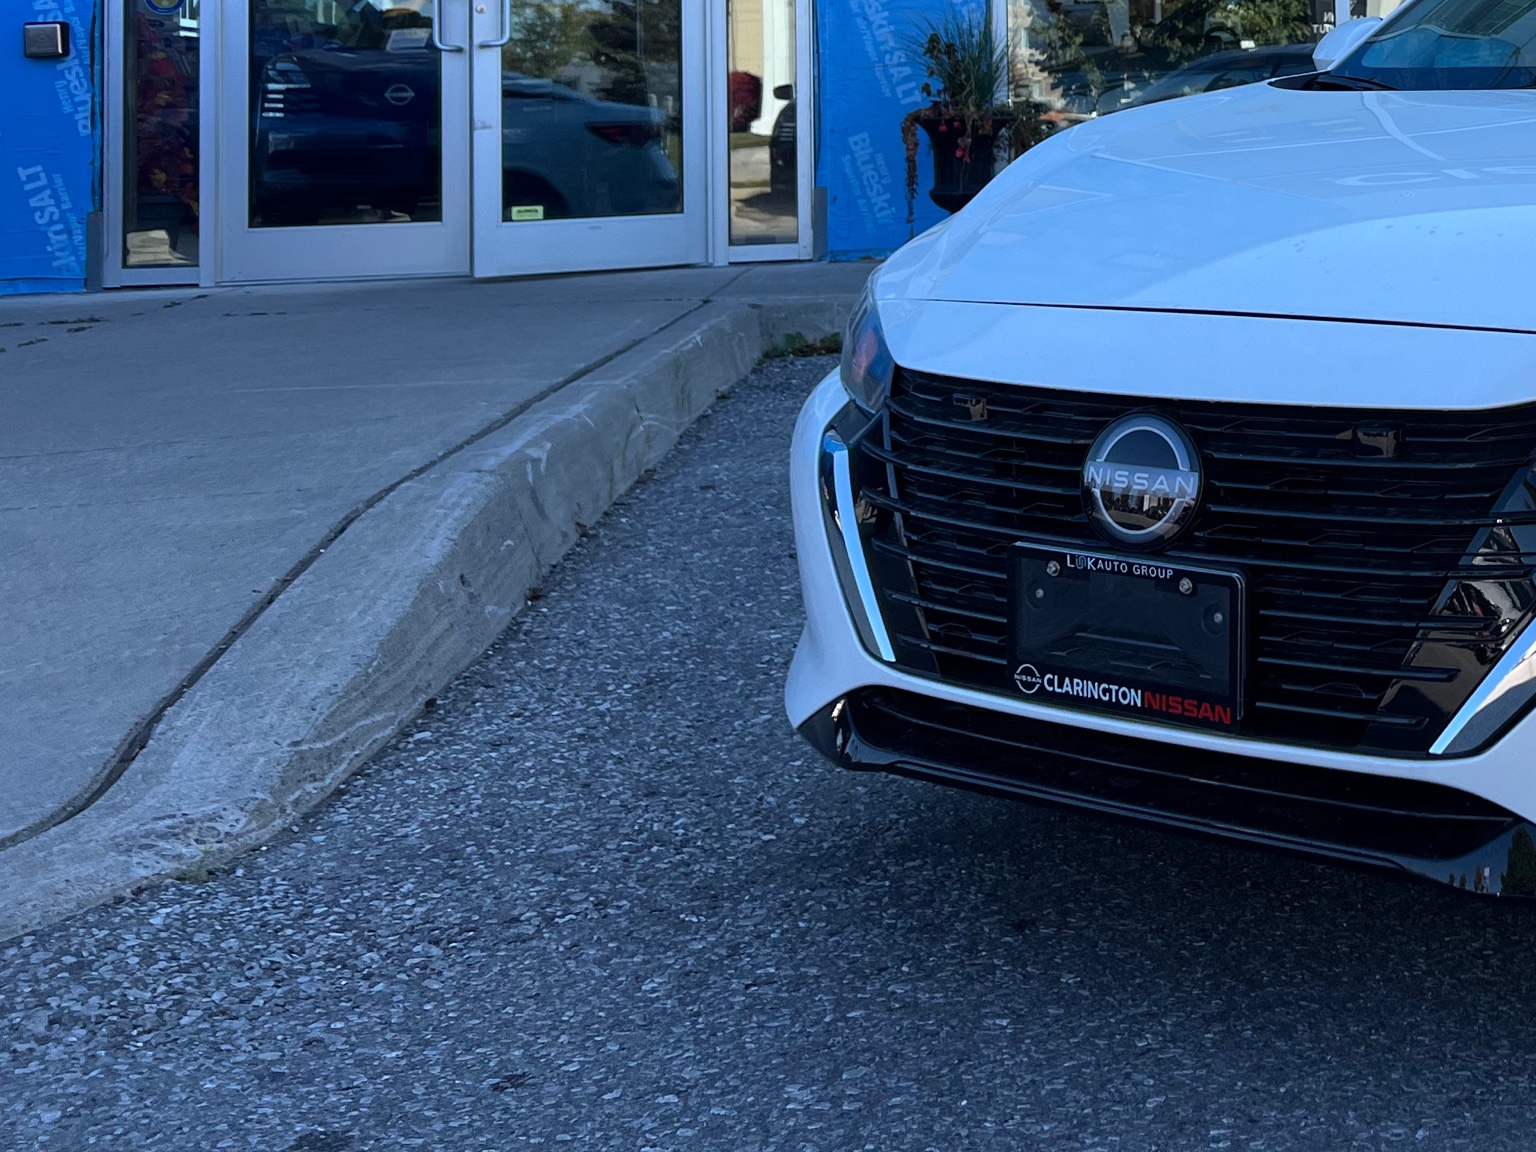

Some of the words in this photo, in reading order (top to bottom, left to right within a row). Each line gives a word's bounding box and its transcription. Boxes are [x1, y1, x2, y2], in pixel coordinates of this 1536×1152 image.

[1086, 466, 1194, 494] NISSAN
[1097, 559, 1128, 573] AUTO
[1132, 564, 1173, 579] GROUP
[1014, 674, 1042, 684] NISSAN
[1043, 674, 1142, 707] CLARINGTON
[1144, 691, 1231, 725] NISSAN
